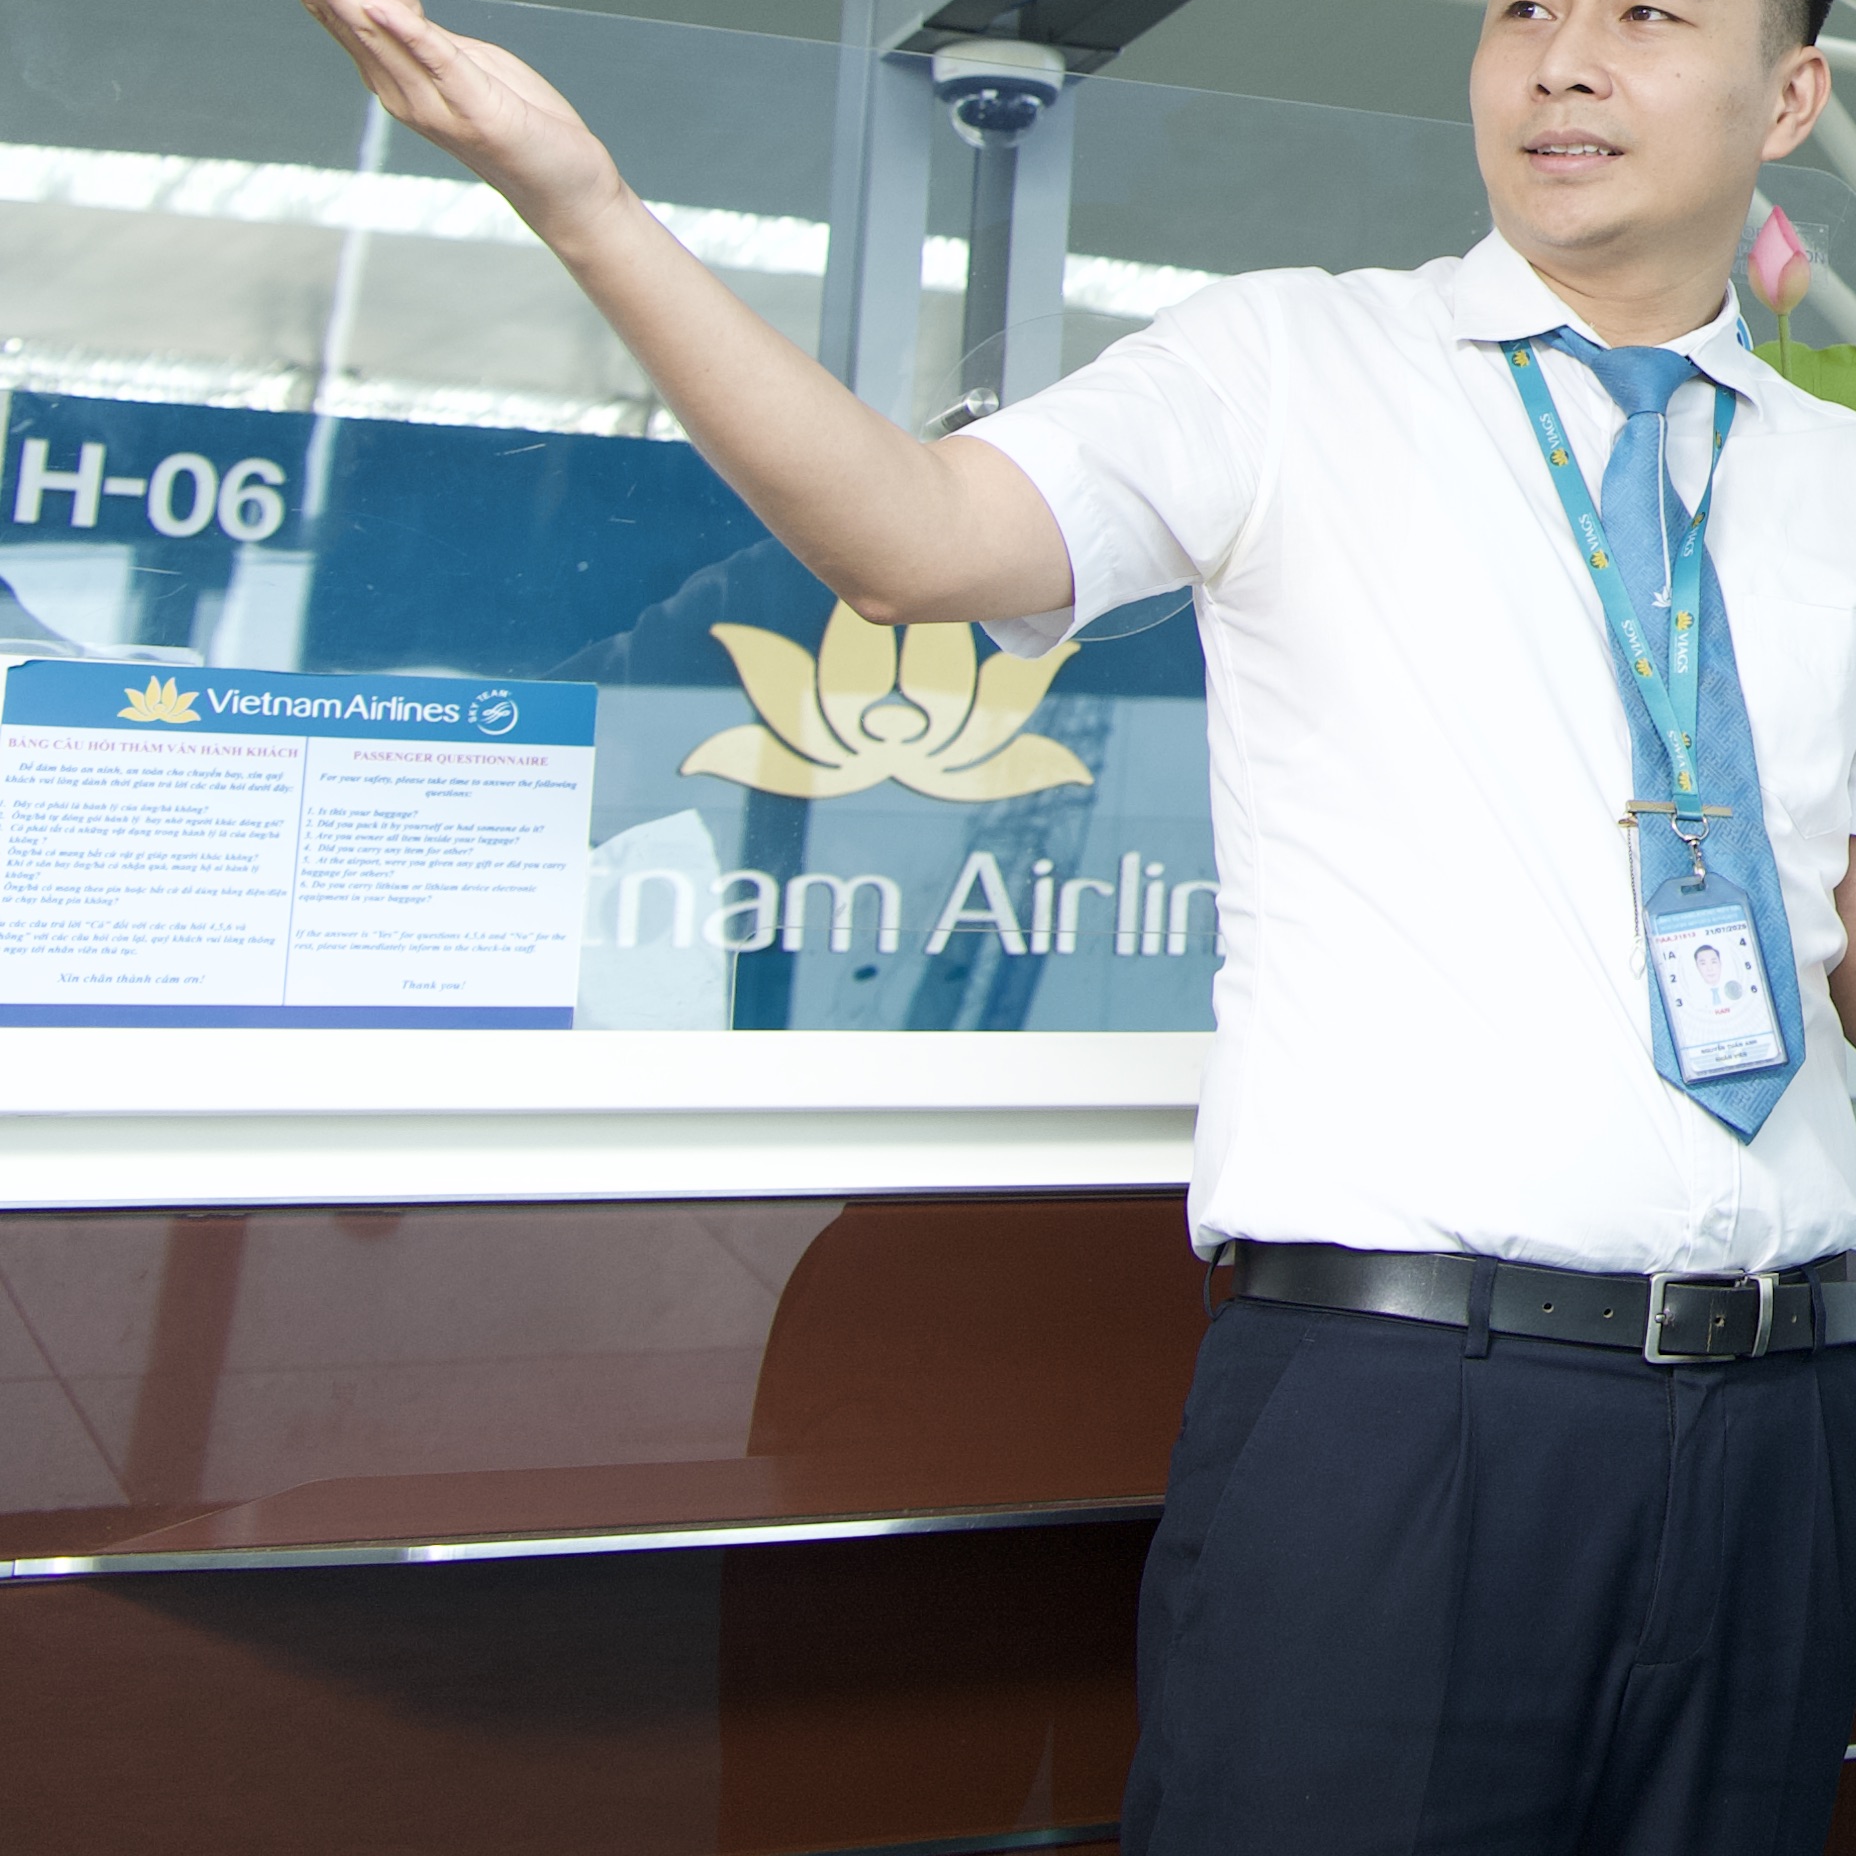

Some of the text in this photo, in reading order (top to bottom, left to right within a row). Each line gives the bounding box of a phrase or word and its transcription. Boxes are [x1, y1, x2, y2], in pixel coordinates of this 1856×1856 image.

[1539, 412, 1562, 448] VIAGS
[12, 437, 287, 542] H-06
[1578, 512, 1600, 551] VIAGS
[1620, 619, 1644, 658] VIAGS
[1676, 632, 1688, 674] VIAGS
[353, 751, 549, 766] PASSENGER QUESTIONNAIRE
[1739, 937, 1746, 946] 4
[402, 980, 466, 992] Thank you!
[1670, 974, 1677, 983] 2
[1676, 999, 1683, 1007] 3
